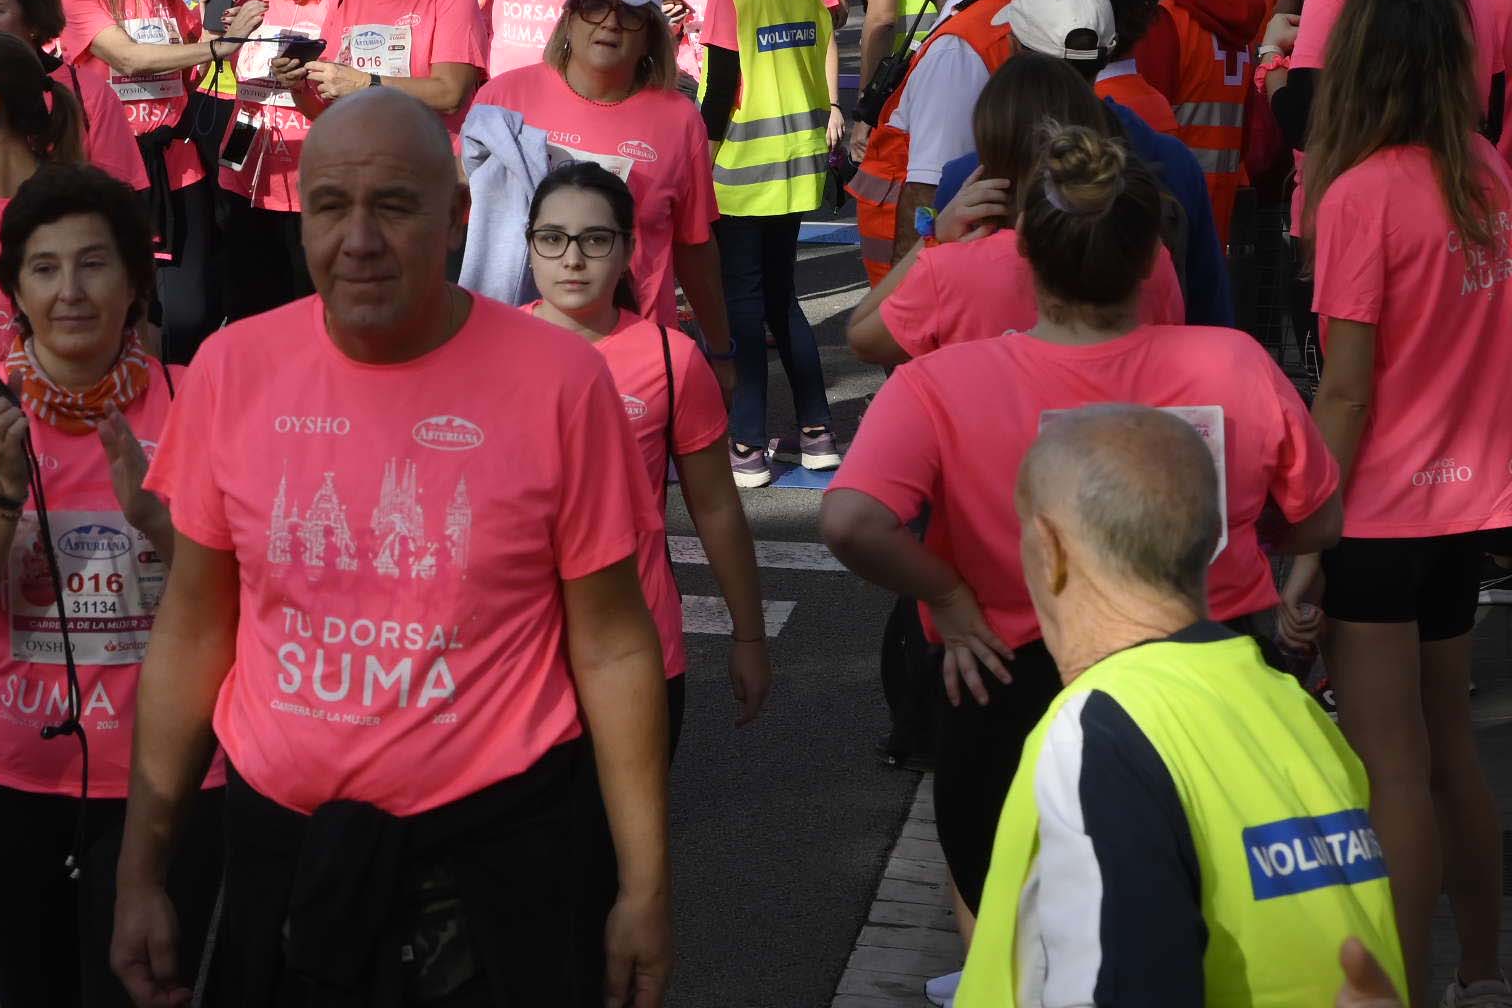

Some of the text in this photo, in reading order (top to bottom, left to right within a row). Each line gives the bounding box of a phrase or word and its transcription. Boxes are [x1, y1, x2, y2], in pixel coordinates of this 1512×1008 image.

[356, 55, 382, 68] 016
[274, 415, 351, 437] OYSHO
[417, 426, 479, 446] ASTURIANA
[64, 537, 127, 553] ASTURIANA
[66, 572, 124, 594] 016
[72, 600, 117, 614] 31134
[30, 620, 75, 630] CARREA
[76, 621, 89, 630] DE
[92, 621, 106, 630] LA
[281, 606, 464, 651] TU DORSAL
[277, 641, 457, 709] SUMA
[0, 673, 116, 717] SUMA
[312, 706, 327, 721] DE
[327, 710, 341, 723] LA
[342, 714, 381, 728] MUJER
